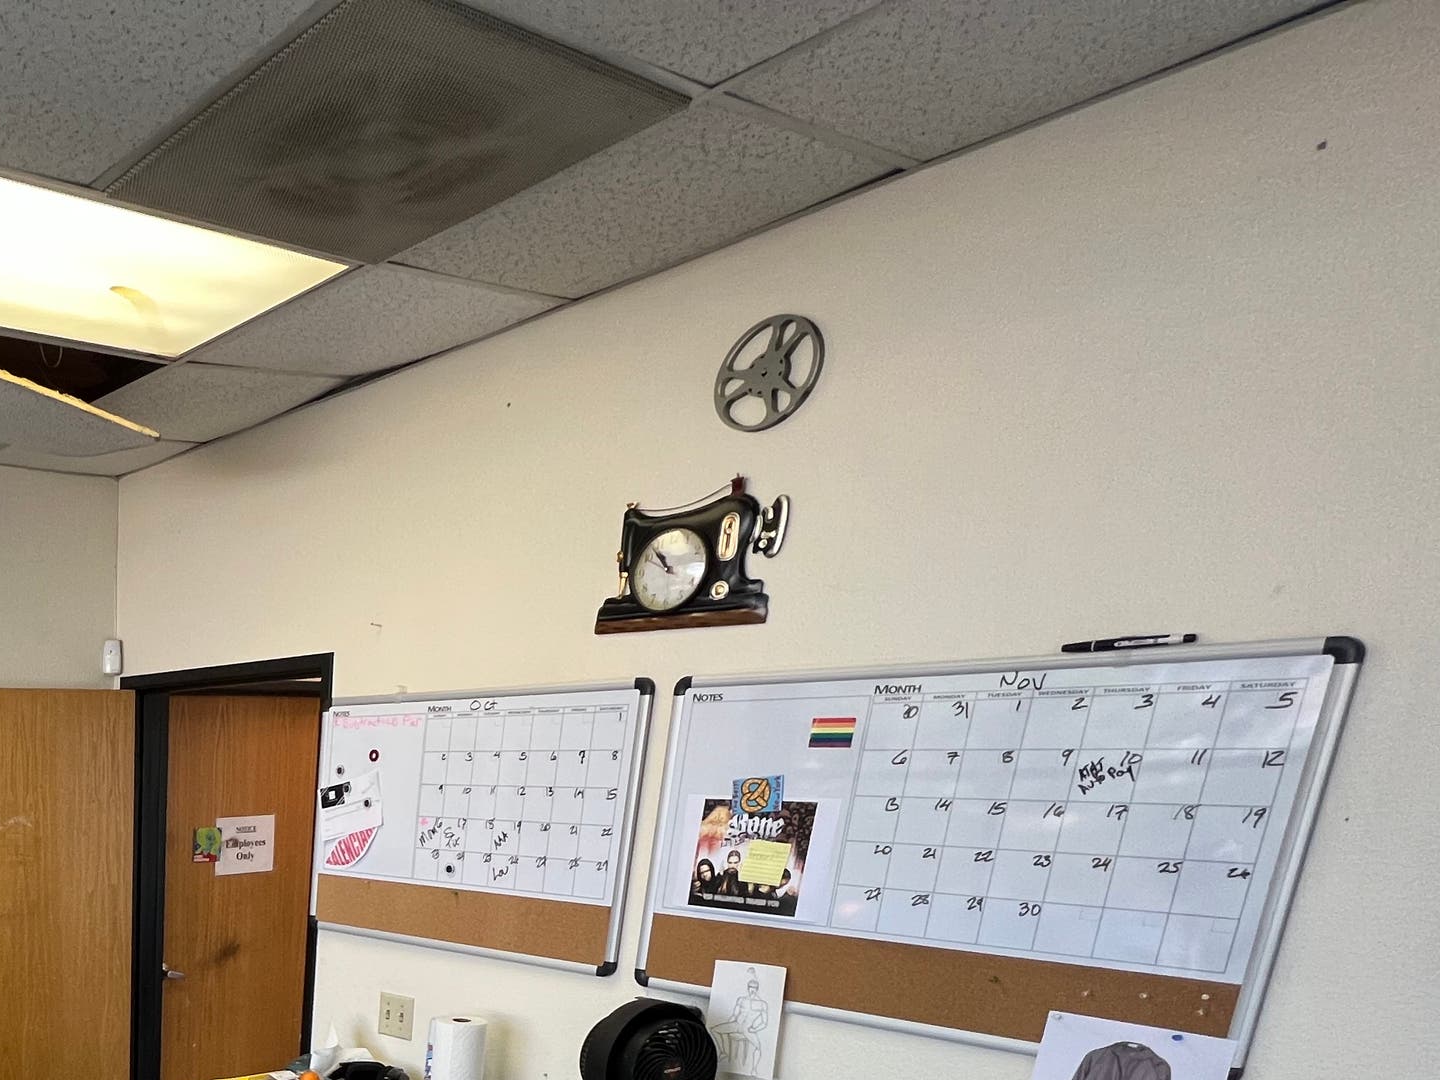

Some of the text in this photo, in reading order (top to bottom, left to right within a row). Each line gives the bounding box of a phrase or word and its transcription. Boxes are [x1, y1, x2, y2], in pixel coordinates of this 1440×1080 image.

[874, 684, 922, 695] MONTH
[692, 693, 724, 702] NOTES
[951, 701, 969, 719] 31
[1071, 697, 1088, 710] 2
[1134, 694, 1154, 709] 3
[1201, 695, 1221, 708] 4
[1265, 692, 1298, 709] 5
[465, 752, 473, 761] 3
[493, 751, 501, 759] 4
[519, 752, 527, 761] 5
[550, 751, 557, 761] 6
[612, 751, 618, 760] 8
[891, 749, 1285, 768] 6 7 8 9 10 11 12
[517, 787, 527, 796] 12
[545, 786, 554, 797] 13
[606, 788, 618, 800] 15
[935, 798, 952, 811] 14
[987, 802, 1007, 815] 15
[1043, 803, 1065, 818] 16
[1107, 804, 1129, 821] 17
[1173, 804, 1202, 820] 18
[1242, 807, 1267, 828] 19
[514, 820, 522, 834] 19
[601, 827, 613, 837] 22
[225, 838, 266, 850] Employees
[236, 851, 255, 862] Only
[922, 848, 937, 859] 21
[974, 850, 994, 862] 22
[1032, 855, 1052, 867] 23
[1092, 857, 1112, 872] 24
[1157, 861, 1183, 874] 25
[596, 860, 609, 872] 29
[864, 887, 1042, 917] 27 28 29 30
